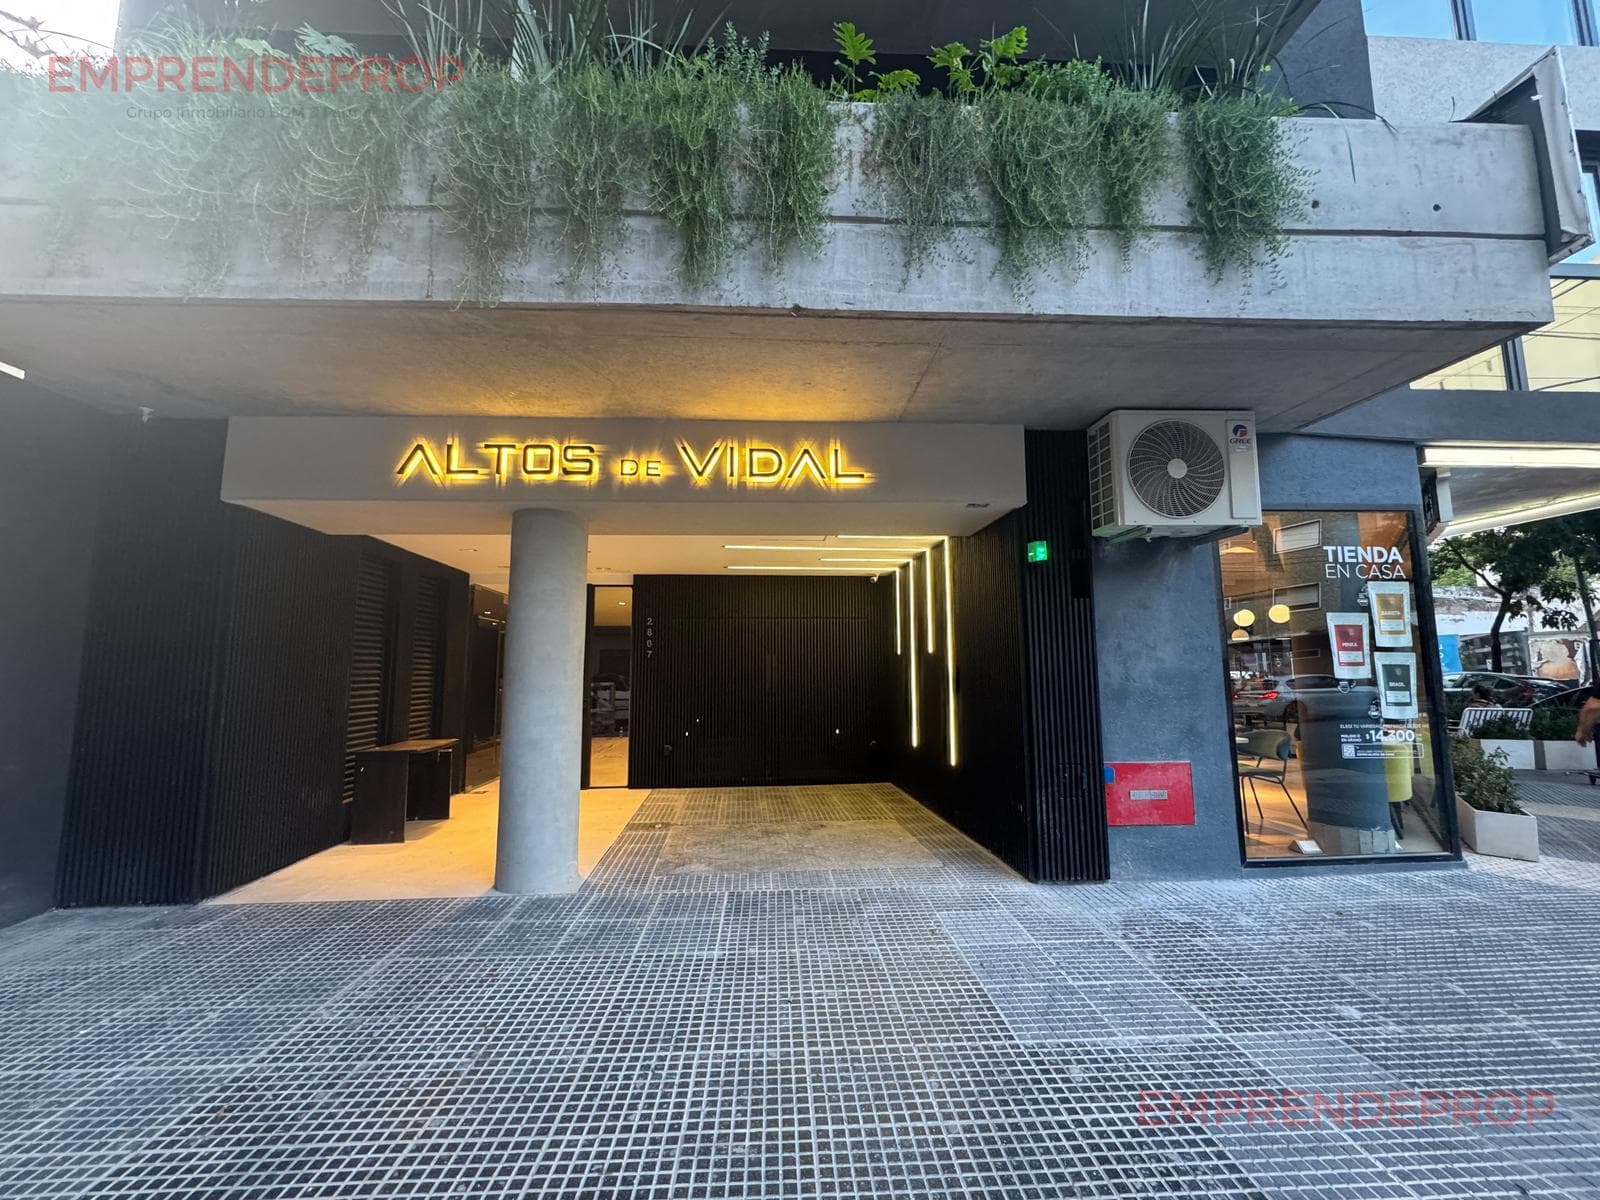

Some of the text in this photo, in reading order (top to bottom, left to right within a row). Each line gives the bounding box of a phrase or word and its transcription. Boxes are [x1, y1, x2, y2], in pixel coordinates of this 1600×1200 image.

[397, 444, 865, 479] ALTOS DE VIDAL
[1323, 546, 1404, 563] TIENDA
[1325, 563, 1406, 579] EN CASA
